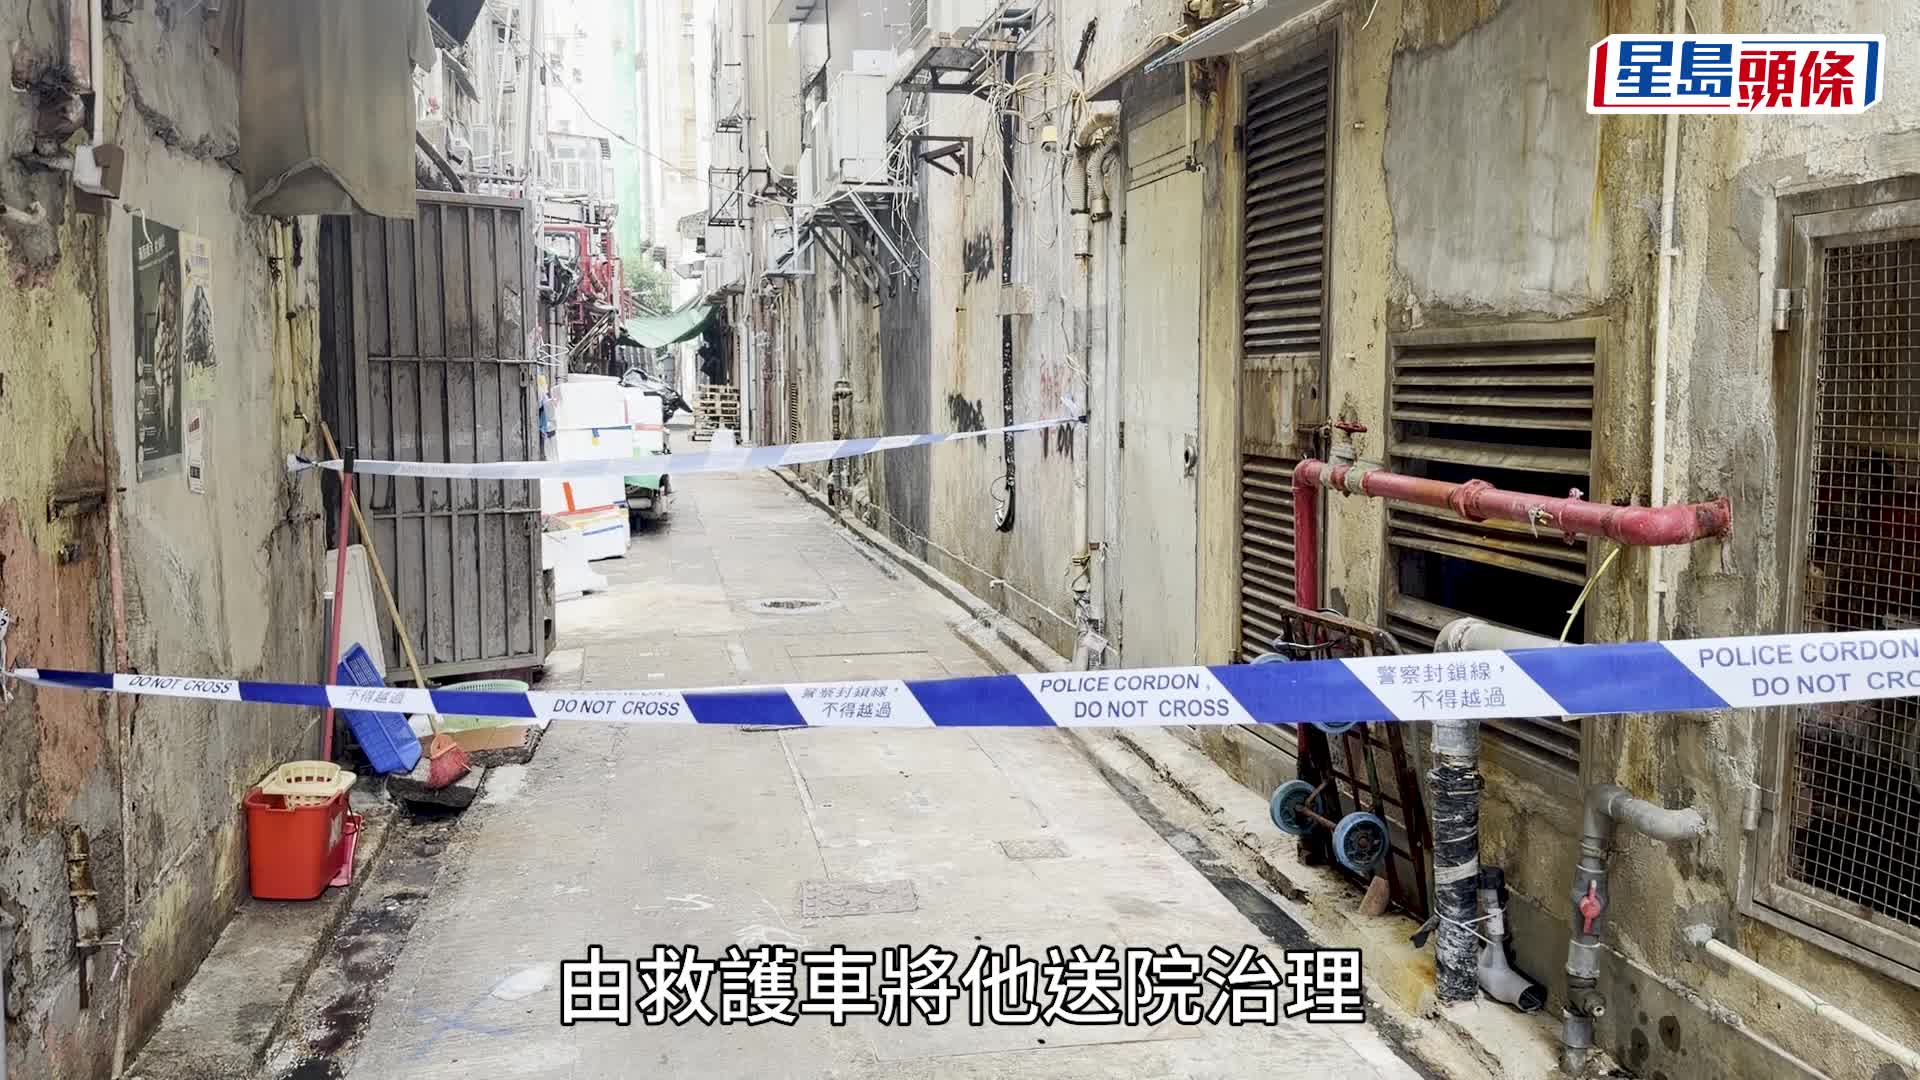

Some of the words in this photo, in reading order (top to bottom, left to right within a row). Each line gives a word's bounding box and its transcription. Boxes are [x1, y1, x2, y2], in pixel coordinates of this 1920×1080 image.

[1699, 643, 1793, 668] POLICE
[129, 676, 151, 687] DO
[151, 677, 181, 690] NOT
[183, 680, 233, 694] CROSS
[1039, 676, 1109, 693] POLICE
[1752, 676, 1790, 697] DO
[1796, 673, 1852, 694] NOT
[553, 698, 578, 713] DO
[580, 699, 617, 714] NOT
[622, 700, 680, 716] CROSS
[1411, 686, 1506, 710] 不得越過
[822, 701, 891, 719] 不得越過
[1074, 700, 1103, 718] DO
[1108, 700, 1149, 718] NOT
[1158, 698, 1230, 717] CROSS
